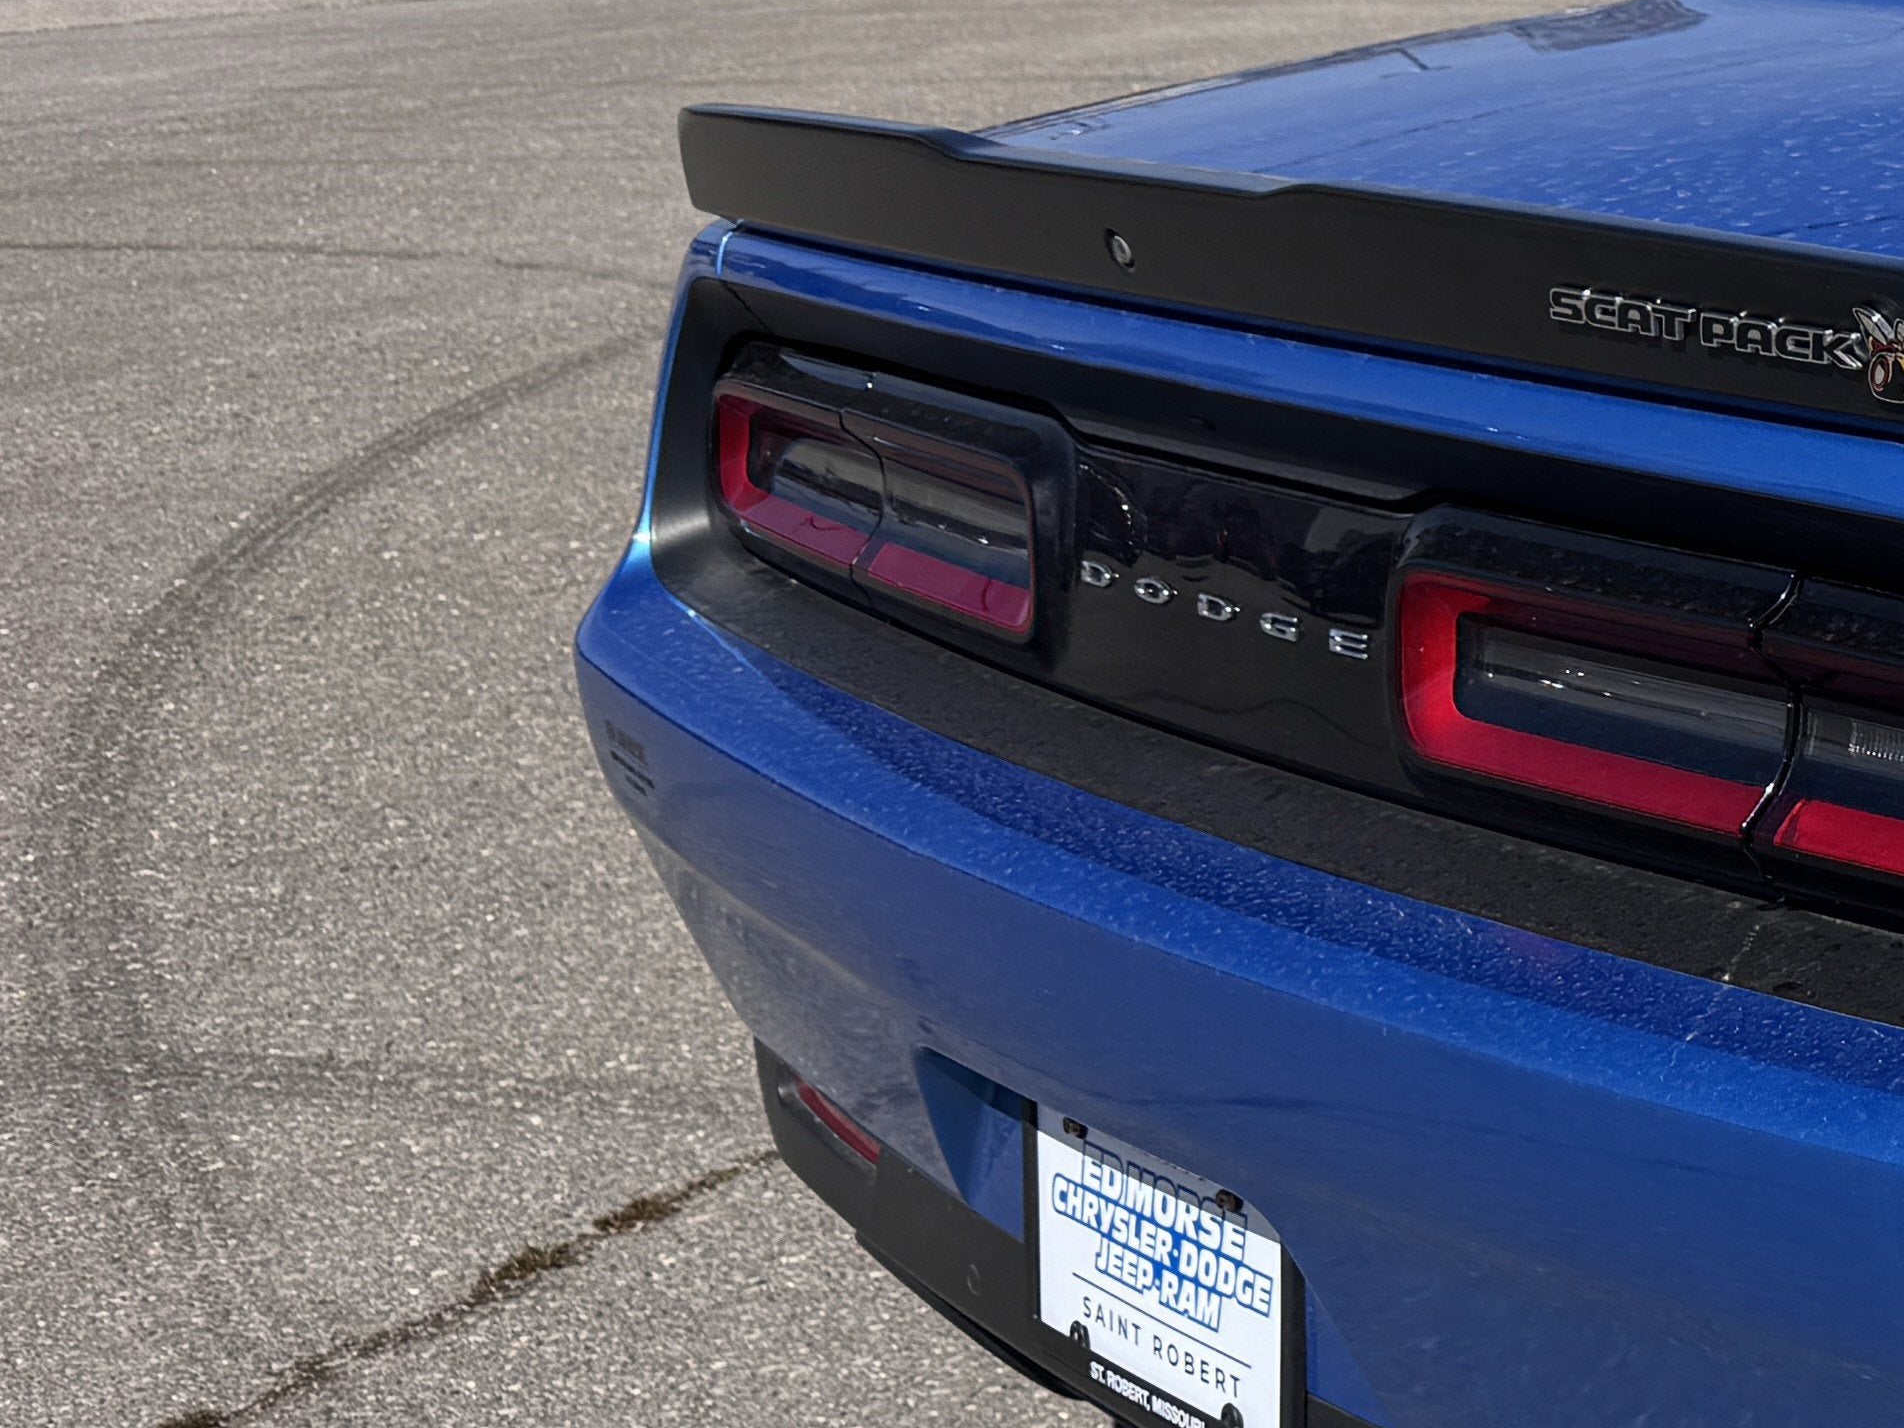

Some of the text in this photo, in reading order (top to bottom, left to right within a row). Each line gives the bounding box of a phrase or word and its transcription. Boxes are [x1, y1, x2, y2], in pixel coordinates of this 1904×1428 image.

[1549, 287, 1863, 370] SCAT PACK
[1081, 560, 1369, 660] DODGE
[1082, 1139, 1248, 1263] ED MORSE
[1082, 1295, 1241, 1400] SAINT ROBERT
[1090, 1360, 1106, 1385] ST.
